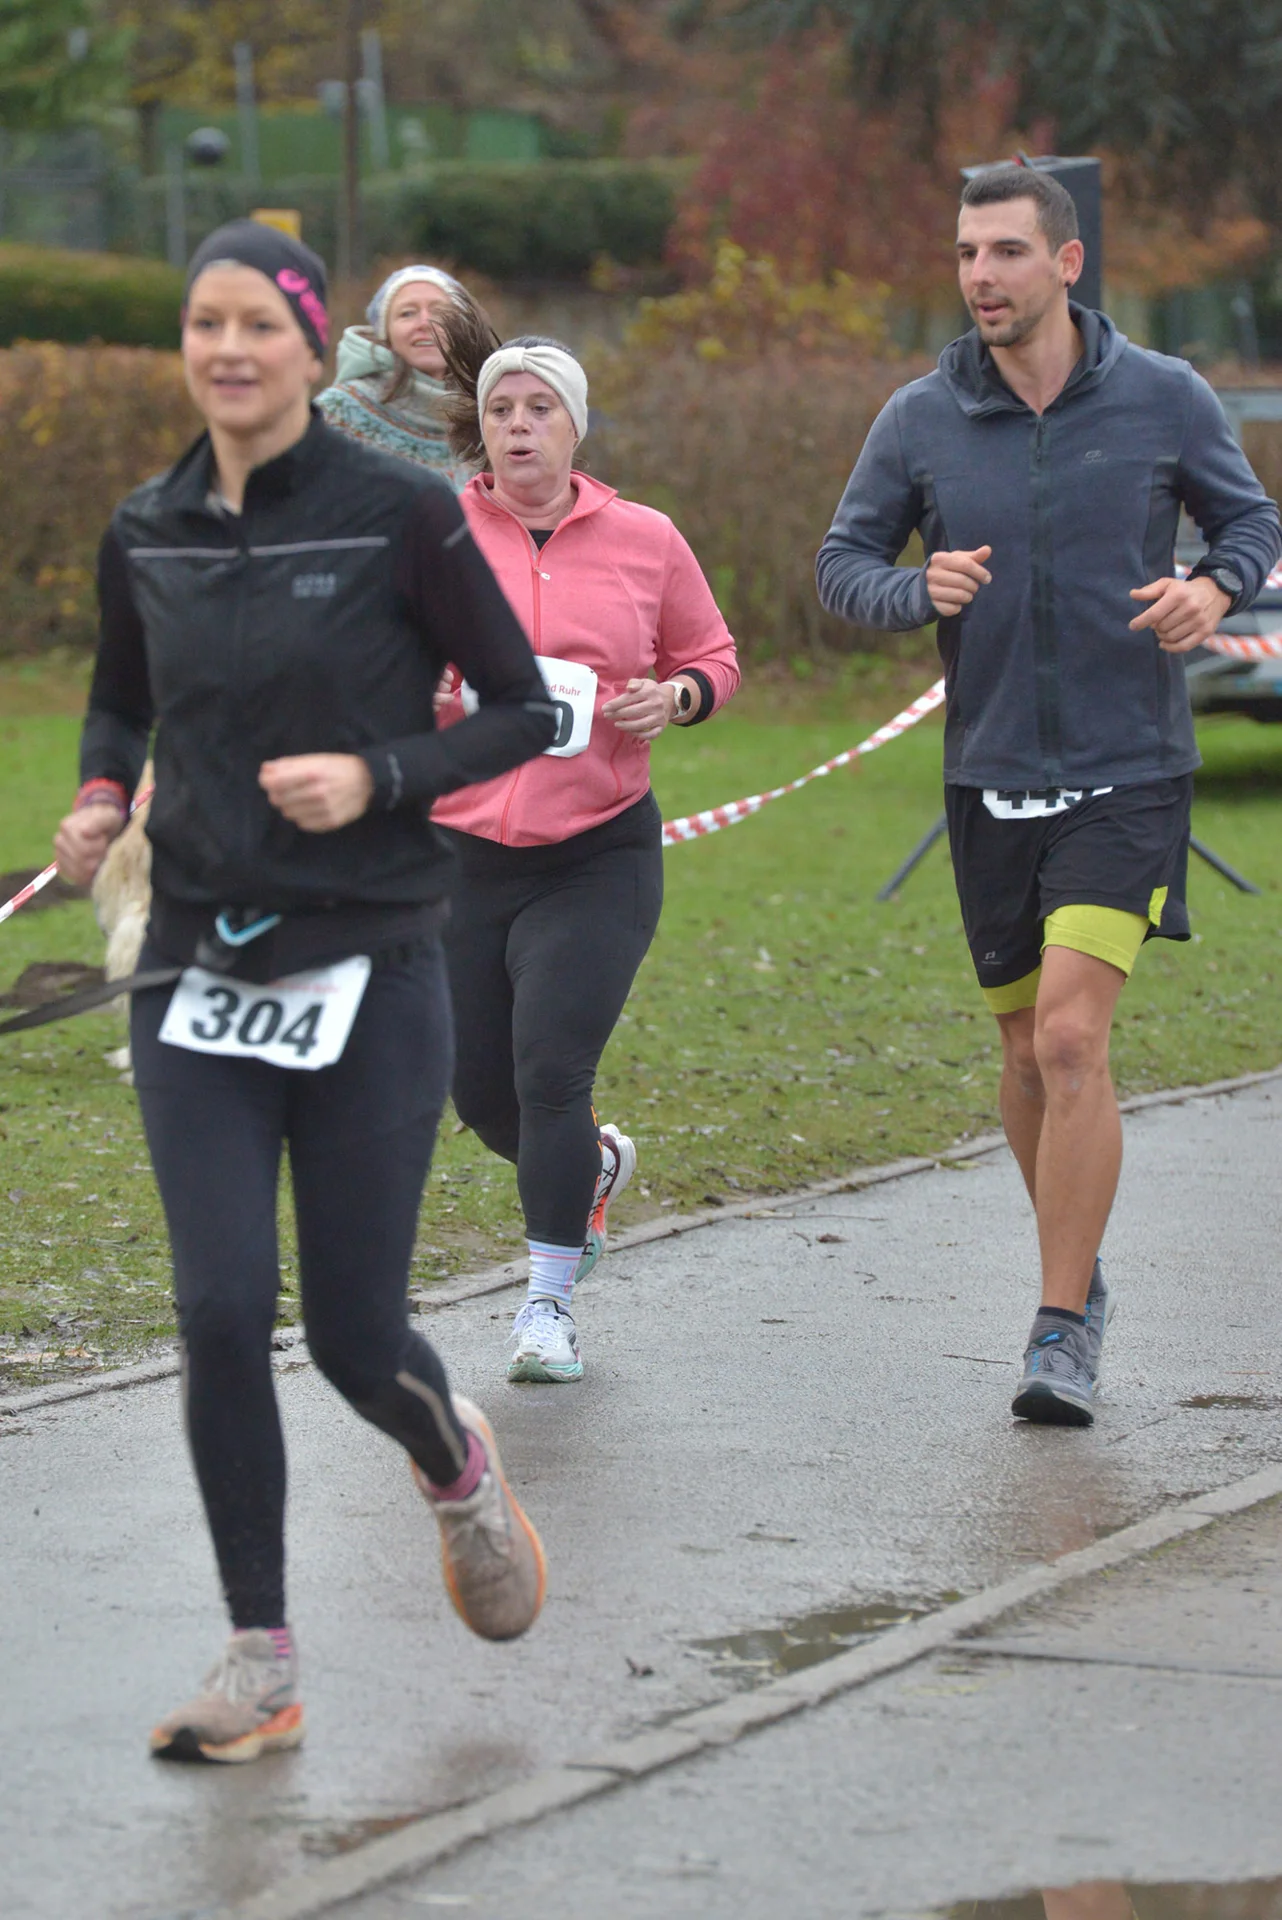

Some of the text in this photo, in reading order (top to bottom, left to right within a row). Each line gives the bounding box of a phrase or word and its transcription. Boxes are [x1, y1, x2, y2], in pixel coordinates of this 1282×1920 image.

[559, 684, 581, 697] Ruhr
[550, 699, 575, 748] 0
[190, 986, 325, 1058] 304
